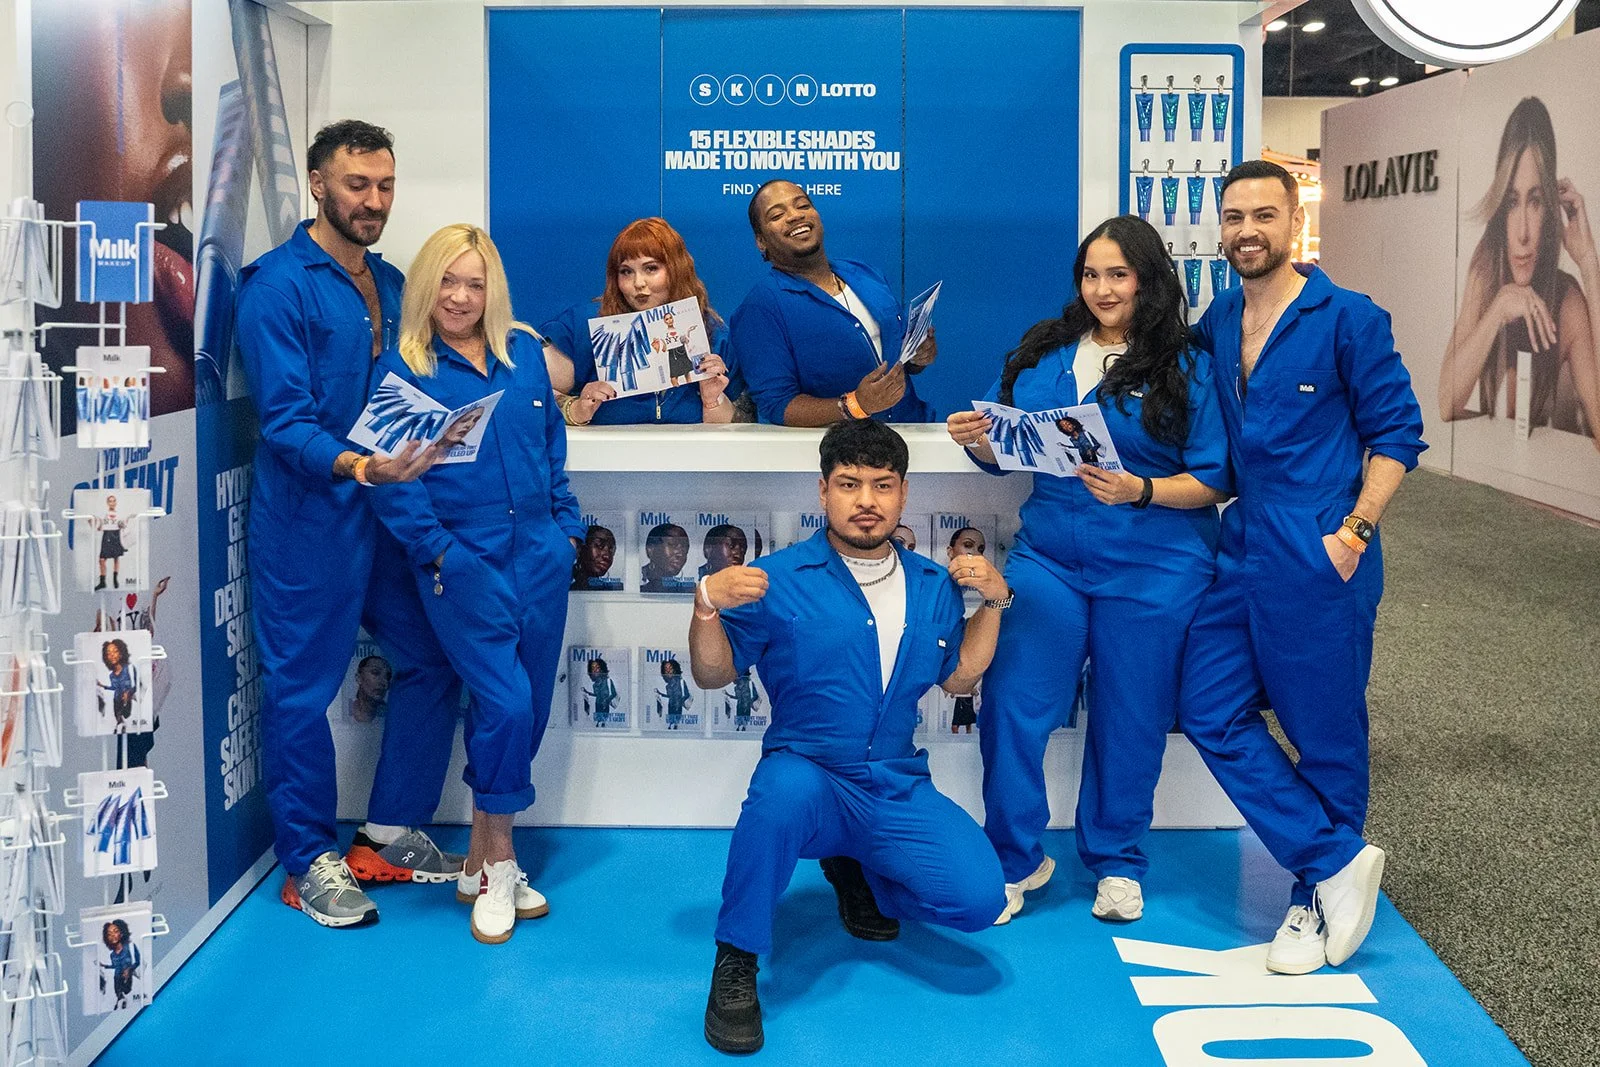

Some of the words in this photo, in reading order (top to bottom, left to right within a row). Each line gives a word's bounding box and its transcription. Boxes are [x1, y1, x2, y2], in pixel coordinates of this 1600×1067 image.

[821, 83, 876, 97] LOTTO
[689, 130, 711, 149] 15
[713, 130, 796, 149] FLEXIBLE
[798, 130, 876, 150] SHADES
[665, 151, 720, 169] MADE
[723, 151, 749, 169] TO
[750, 151, 804, 169] MOVE
[807, 151, 858, 170] WITH
[861, 151, 901, 170] YOU
[1343, 149, 1439, 202] LOLAVIE
[723, 184, 753, 195] FIND
[806, 184, 841, 195] HERE
[89, 238, 139, 259] Milk
[645, 305, 676, 323] Milk
[1032, 410, 1068, 423] Milk
[582, 514, 598, 526] ilk
[640, 512, 671, 525] Milk
[699, 513, 730, 526] Milk
[801, 515, 828, 528] Mil
[940, 516, 970, 529] Milk
[573, 648, 602, 662] Milk
[646, 650, 676, 662] Milk
